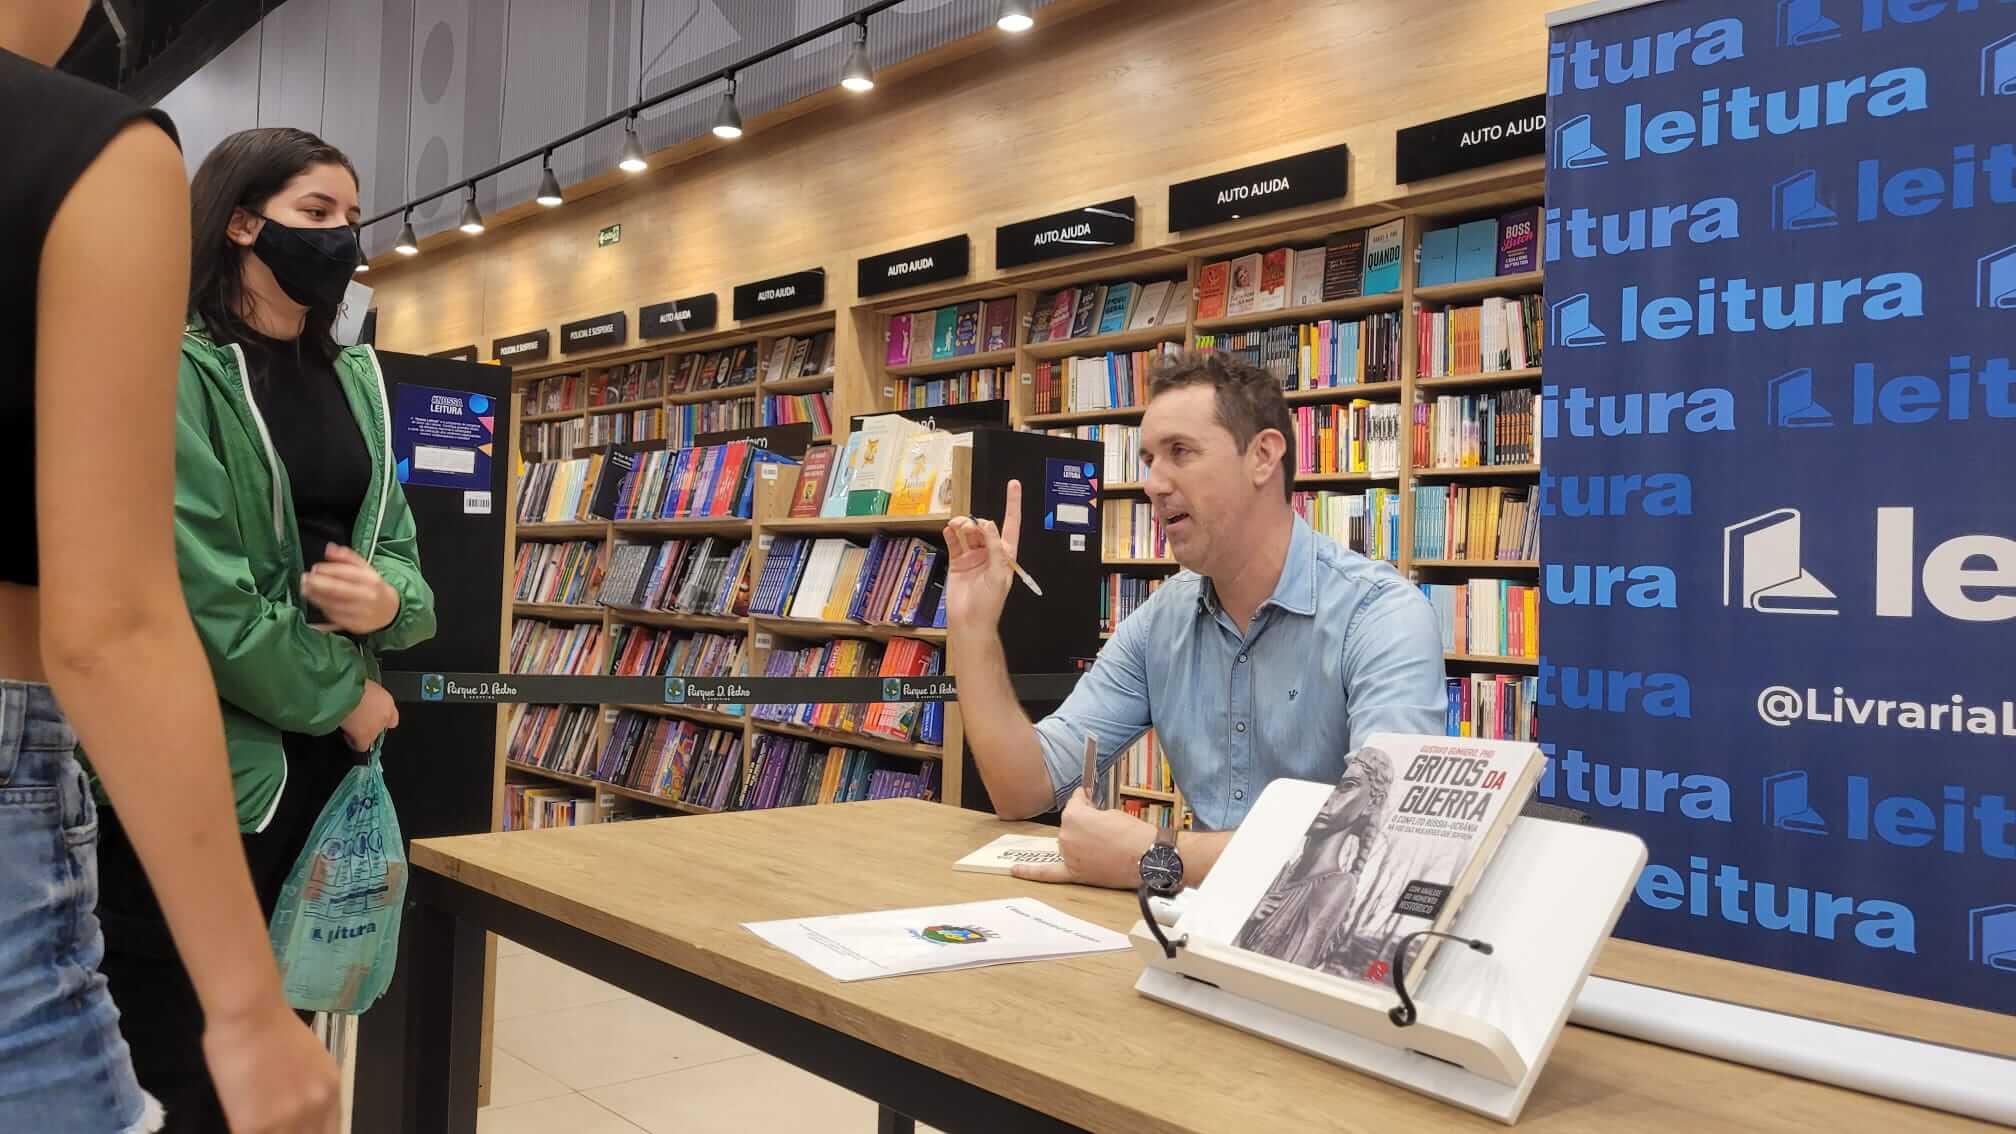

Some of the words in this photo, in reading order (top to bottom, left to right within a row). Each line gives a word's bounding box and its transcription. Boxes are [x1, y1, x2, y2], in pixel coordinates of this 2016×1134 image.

[1549, 17, 1744, 96] itura
[1625, 66, 1928, 160] leitura
[1460, 125, 1502, 148] AUTO
[1217, 186, 1248, 205] AUTO
[1251, 177, 1290, 197] AJUDA
[1033, 230, 1059, 246] AUTO
[1061, 223, 1091, 240] AJUDA
[1506, 222, 1530, 239] BOSS
[1545, 196, 1739, 261] itura
[887, 263, 908, 277] AUTO
[909, 257, 934, 273] AJUDA
[1367, 245, 1401, 271] QUANDO
[758, 288, 776, 301] AUTO
[777, 285, 795, 299] AJUDA
[1621, 272, 1924, 342] leitura
[1853, 355, 2016, 425] leit
[430, 404, 463, 416] LEITURA
[1542, 386, 1735, 439] itura
[447, 681, 478, 699] Parque
[492, 681, 517, 696] Pedro
[687, 684, 715, 701] Parque
[727, 684, 751, 697] Pedro
[903, 683, 928, 700] Parque
[1404, 754, 1488, 787] GRITOS
[1481, 770, 1507, 790] DA
[1538, 743, 1733, 823] itura
[1398, 785, 1492, 822] GUERRA
[1848, 775, 2016, 859] leit
[1634, 856, 1917, 954] eitura
